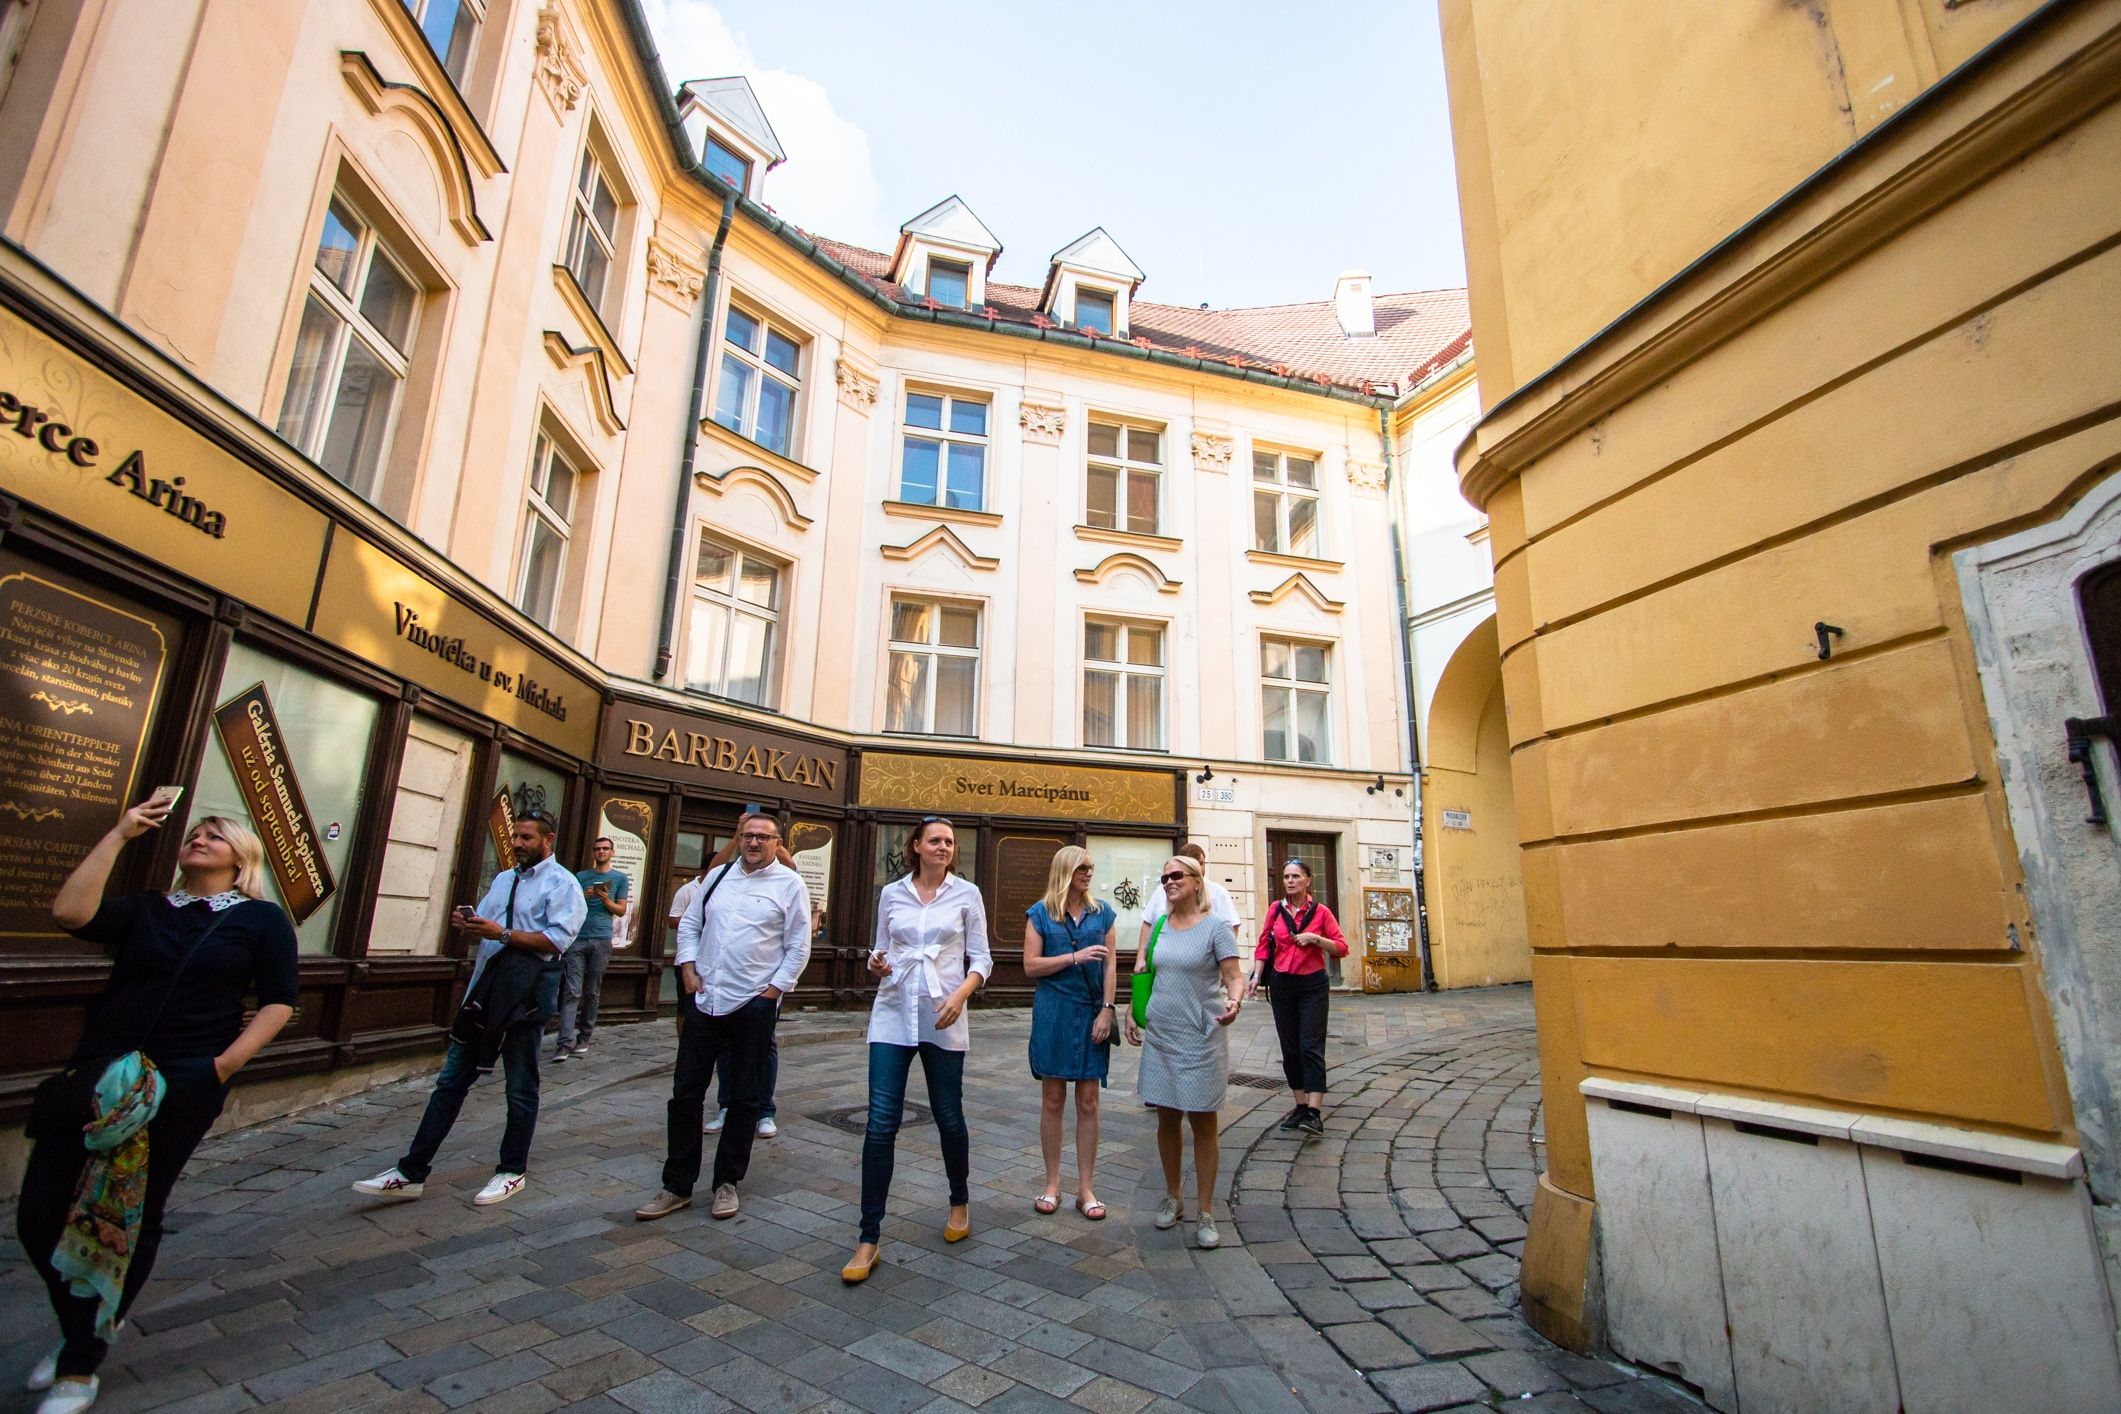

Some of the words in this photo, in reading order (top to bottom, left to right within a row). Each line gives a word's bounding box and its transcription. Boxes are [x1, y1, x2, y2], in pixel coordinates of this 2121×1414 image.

[105, 450, 226, 538] Arina
[63, 619, 115, 646] KOBERCE
[115, 639, 147, 658] ARINA
[20, 651, 39, 664] viac
[41, 657, 60, 671] ako
[61, 663, 75, 675] 20
[76, 668, 102, 685] krajín
[104, 679, 126, 692] sveta
[34, 639, 60, 656] krása
[69, 650, 107, 672] hodvábu
[109, 666, 114, 674] a
[116, 666, 143, 685] bavlny
[84, 645, 95, 653] na
[97, 647, 140, 669] Slovensku
[394, 601, 476, 673] Vinotéka
[480, 661, 492, 682] u
[493, 671, 513, 694] sv.
[516, 673, 567, 722] Michala
[41, 674, 99, 698] starožitnosti,
[101, 691, 135, 709] plastiky
[14, 735, 54, 753] Auswahl
[55, 745, 65, 756] in
[66, 748, 82, 759] der
[84, 751, 120, 767] Slowakei
[25, 723, 121, 754] ORIENTTEPPICHE
[28, 752, 74, 771] Schönheit
[75, 764, 90, 774] aus
[92, 766, 115, 779] Seide
[241, 745, 259, 769] už
[625, 719, 839, 791] BARBAKAN
[4, 777, 68, 798] Antiquitäten,
[69, 788, 118, 805] Skulpturen
[20, 767, 37, 778] aus
[39, 769, 61, 782] über
[63, 773, 75, 784] 20
[77, 776, 112, 792] Ländern
[251, 769, 270, 797] od
[956, 777, 994, 796] Svet
[999, 779, 1091, 803] Marcipánu
[1202, 790, 1211, 799] 25
[247, 700, 277, 766] Galéria
[270, 764, 304, 836] Samuela
[295, 832, 325, 898] Spitzera
[260, 793, 302, 884] septembra!
[502, 840, 512, 856] od
